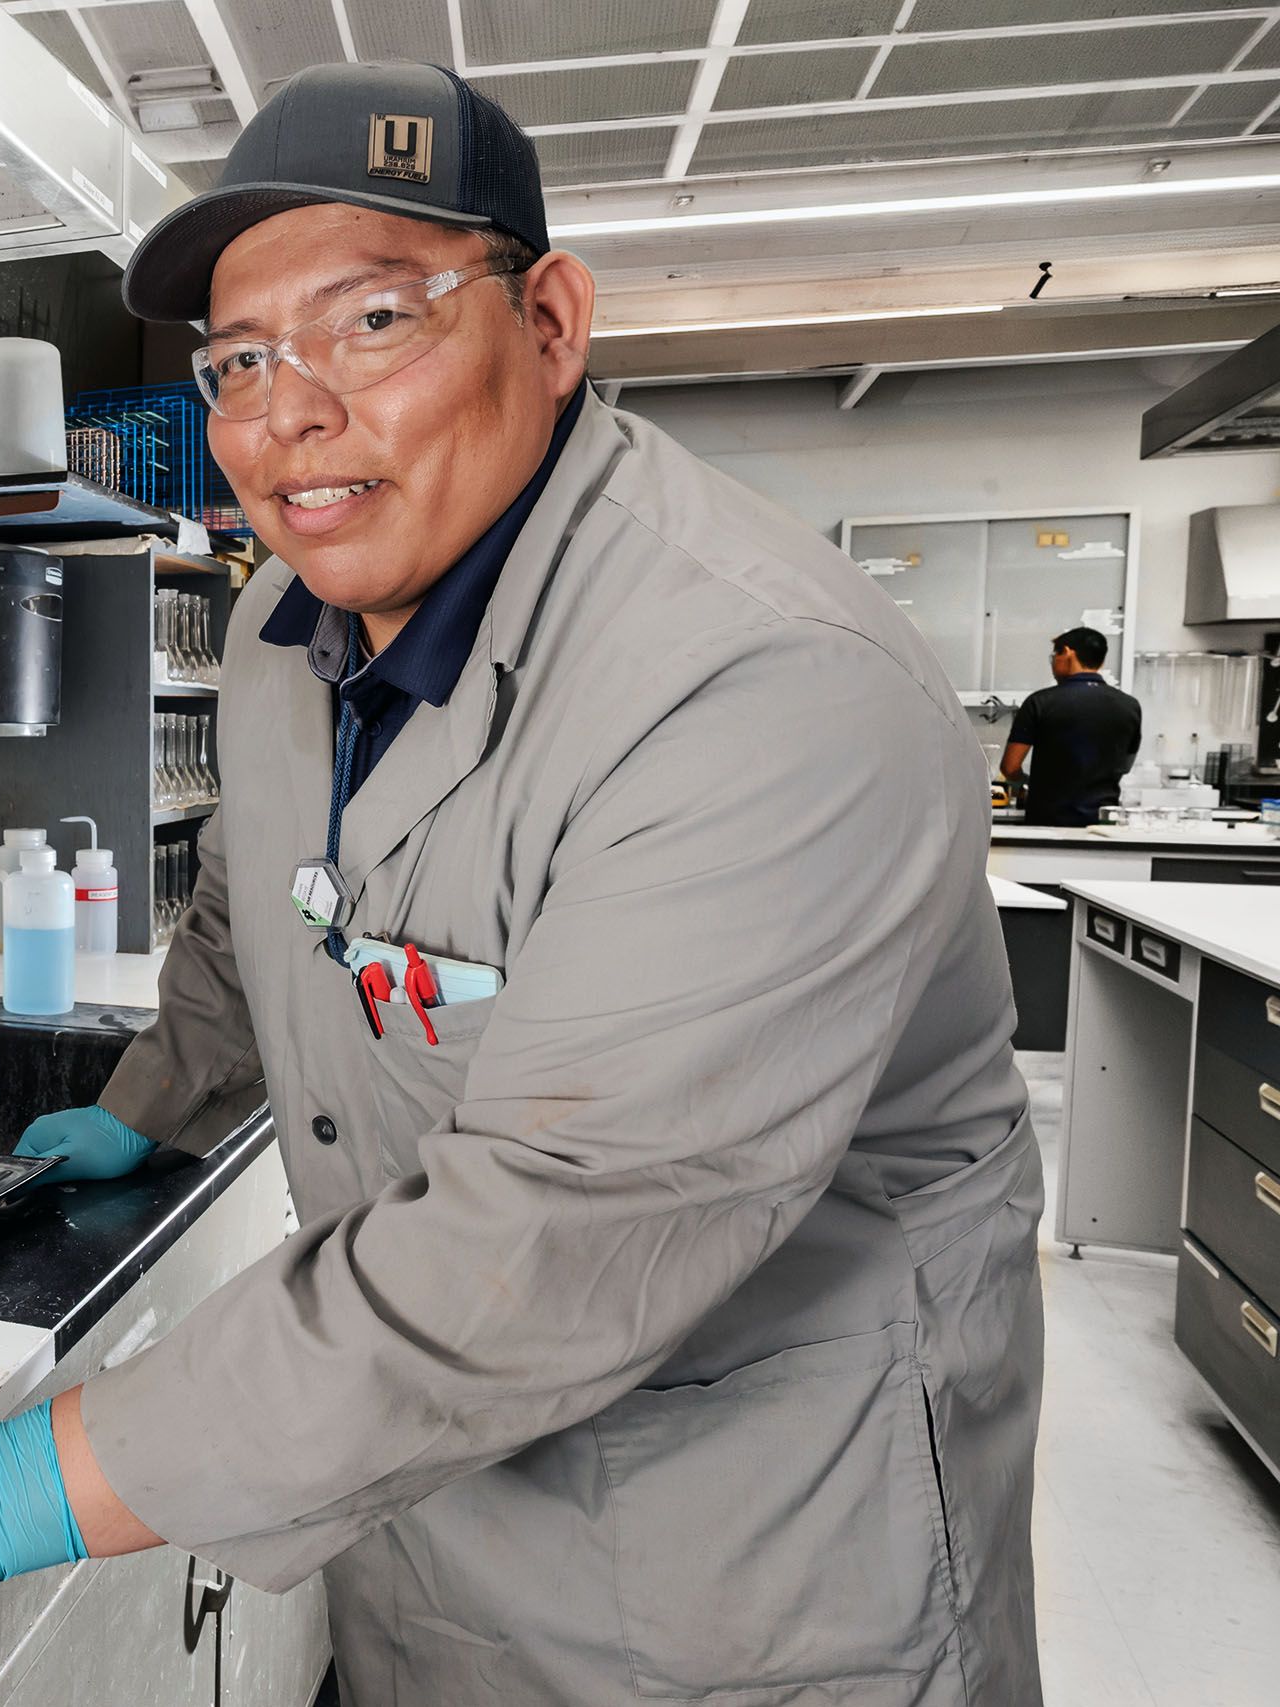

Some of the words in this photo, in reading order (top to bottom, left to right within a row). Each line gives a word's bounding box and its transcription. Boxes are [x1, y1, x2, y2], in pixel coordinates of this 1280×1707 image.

[384, 120, 418, 157] U
[369, 168, 403, 176] ENERGY
[402, 171, 429, 181] FUELS
